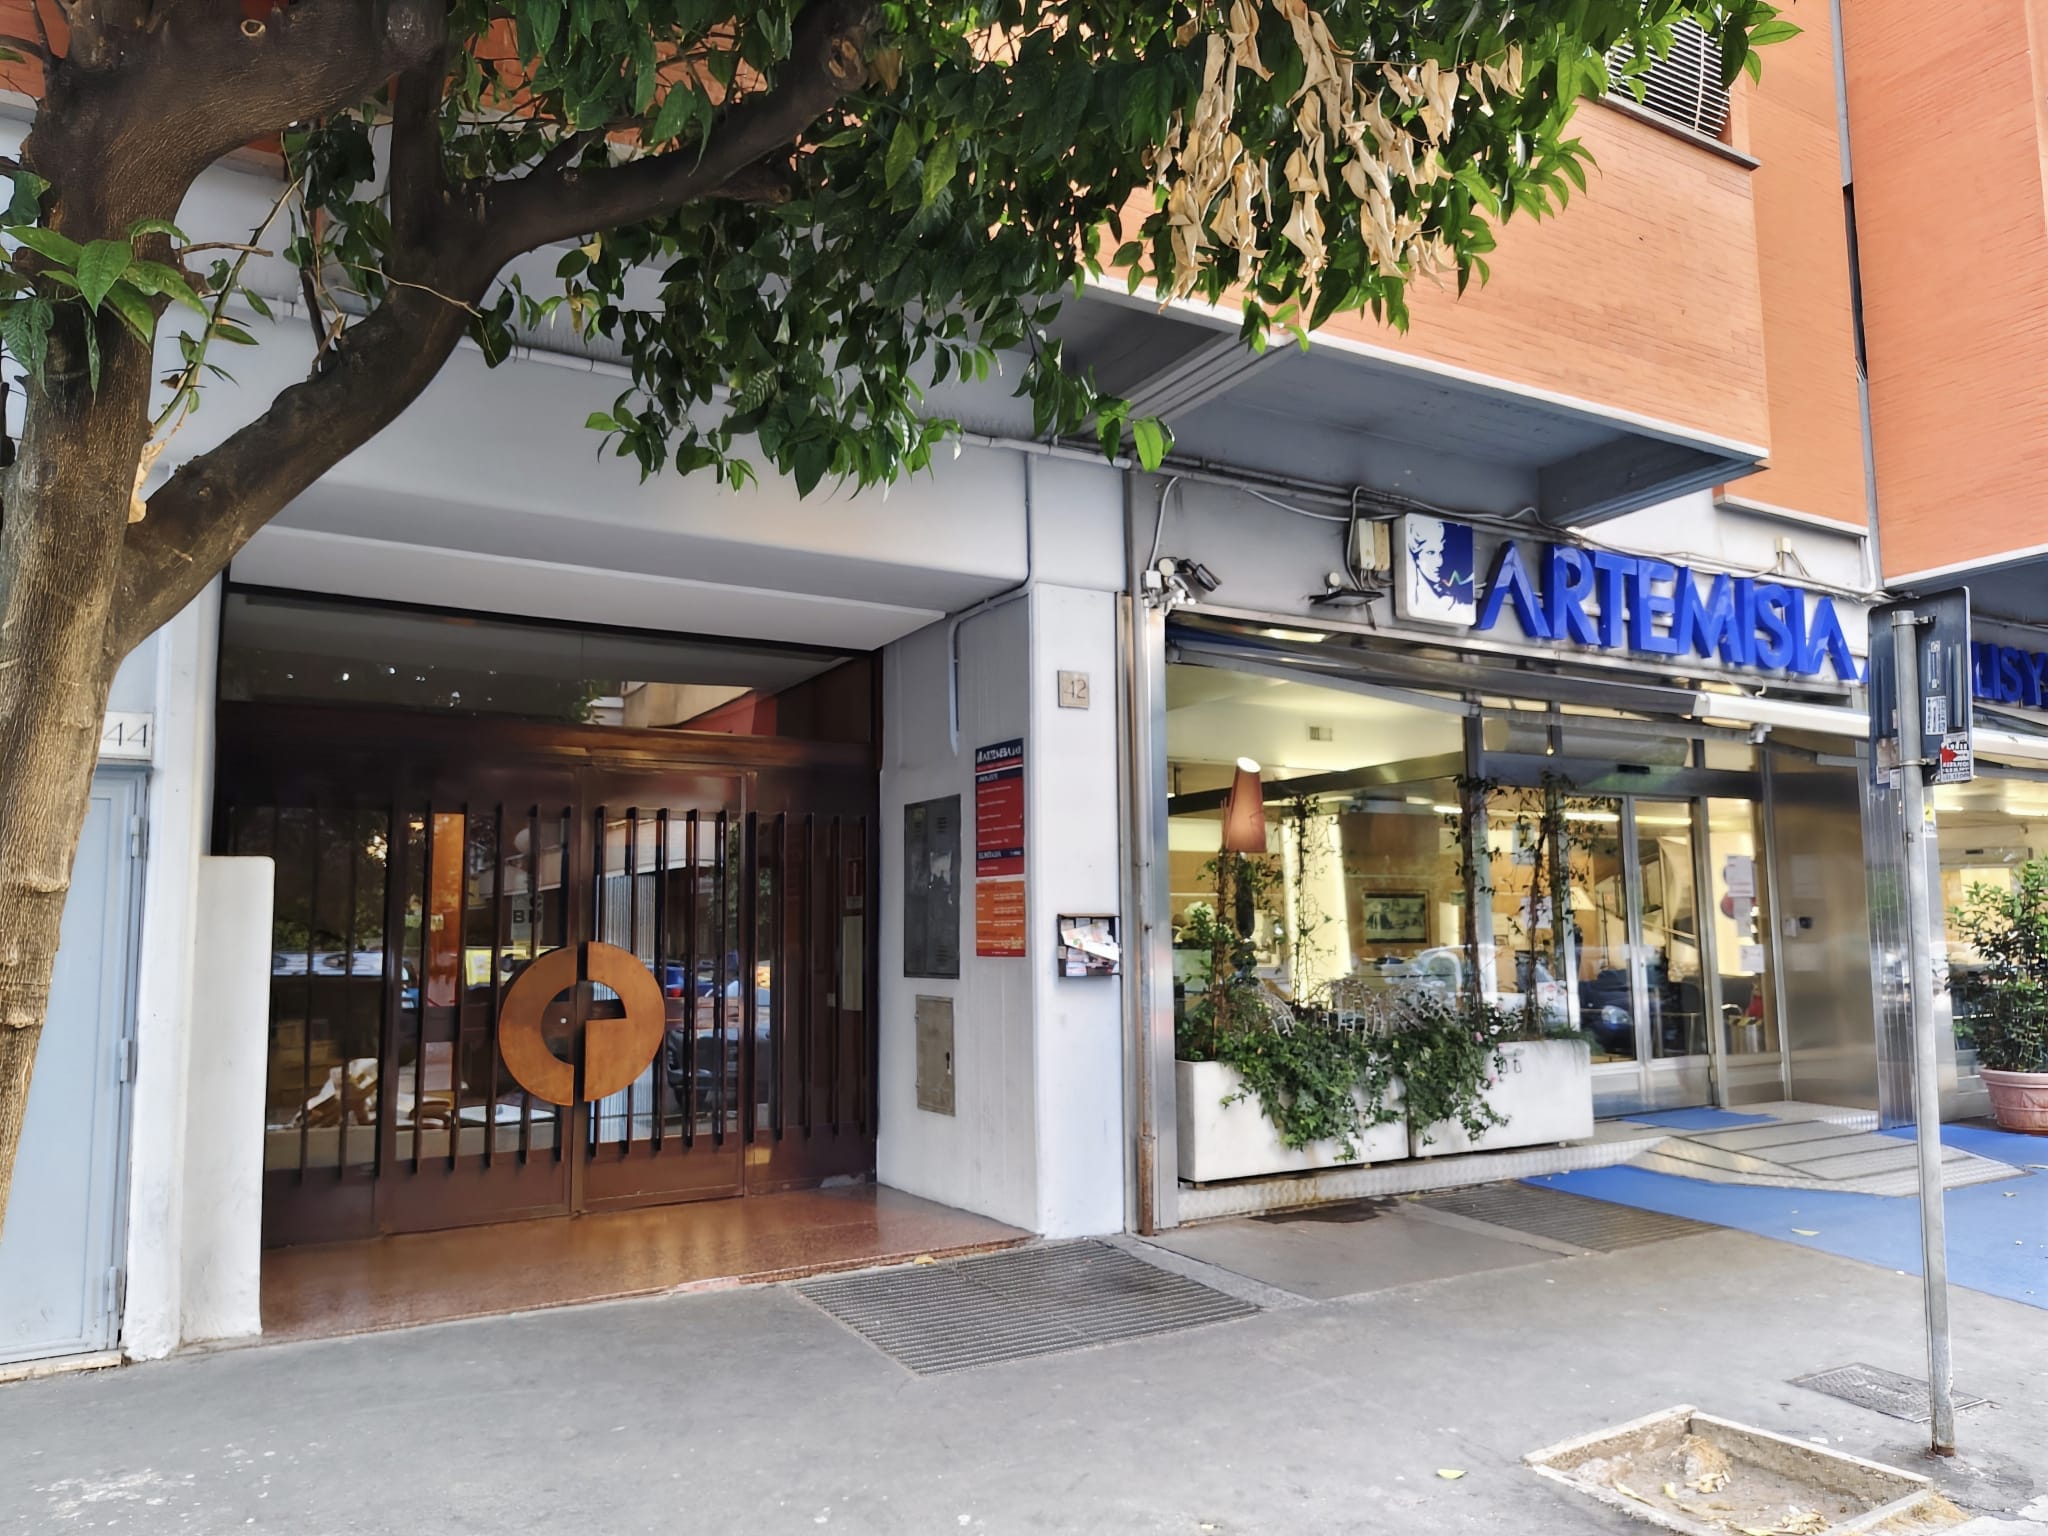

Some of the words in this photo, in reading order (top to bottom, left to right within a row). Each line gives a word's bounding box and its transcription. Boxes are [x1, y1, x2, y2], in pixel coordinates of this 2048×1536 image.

[1475, 540, 1859, 682] ARTEMISIA
[1971, 640, 2048, 708] LISY
[1063, 678, 1087, 699] 42
[103, 721, 147, 748] 44
